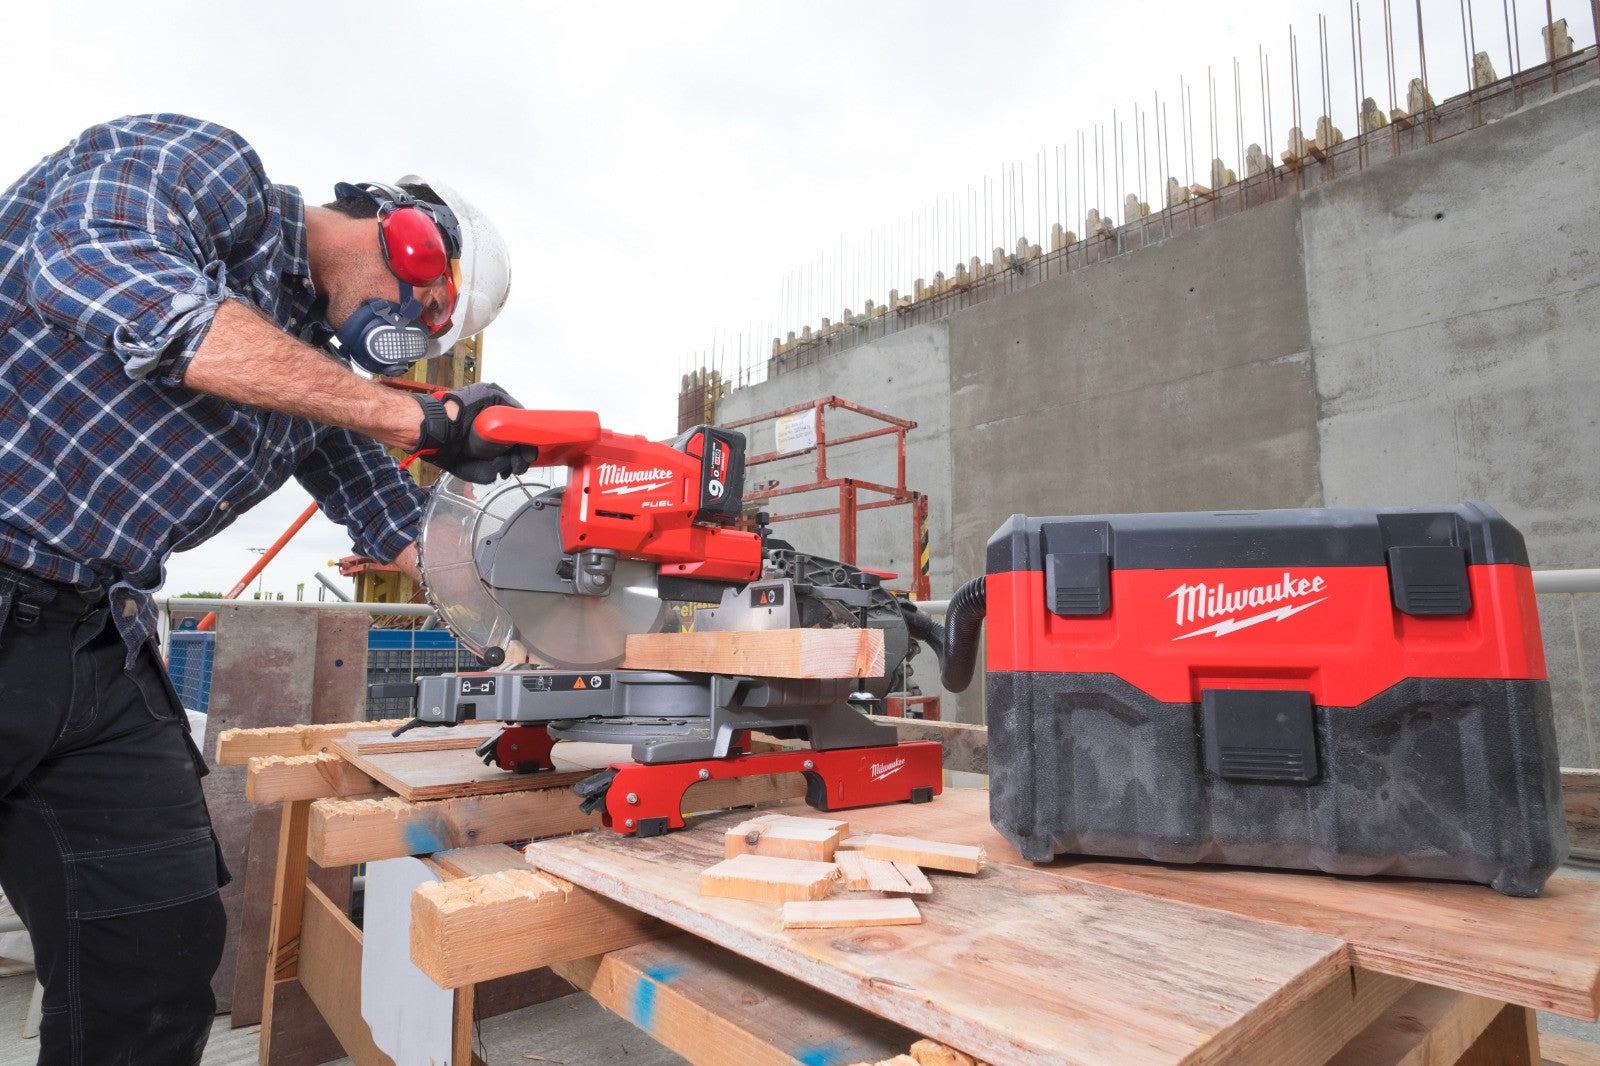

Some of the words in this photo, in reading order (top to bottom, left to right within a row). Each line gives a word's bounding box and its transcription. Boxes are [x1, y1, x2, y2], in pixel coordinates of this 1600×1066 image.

[597, 463, 674, 486] Milwaukee
[641, 500, 674, 508] FUEL
[1166, 572, 1328, 626] Milwaukee
[870, 758, 905, 777] Milwaukee
